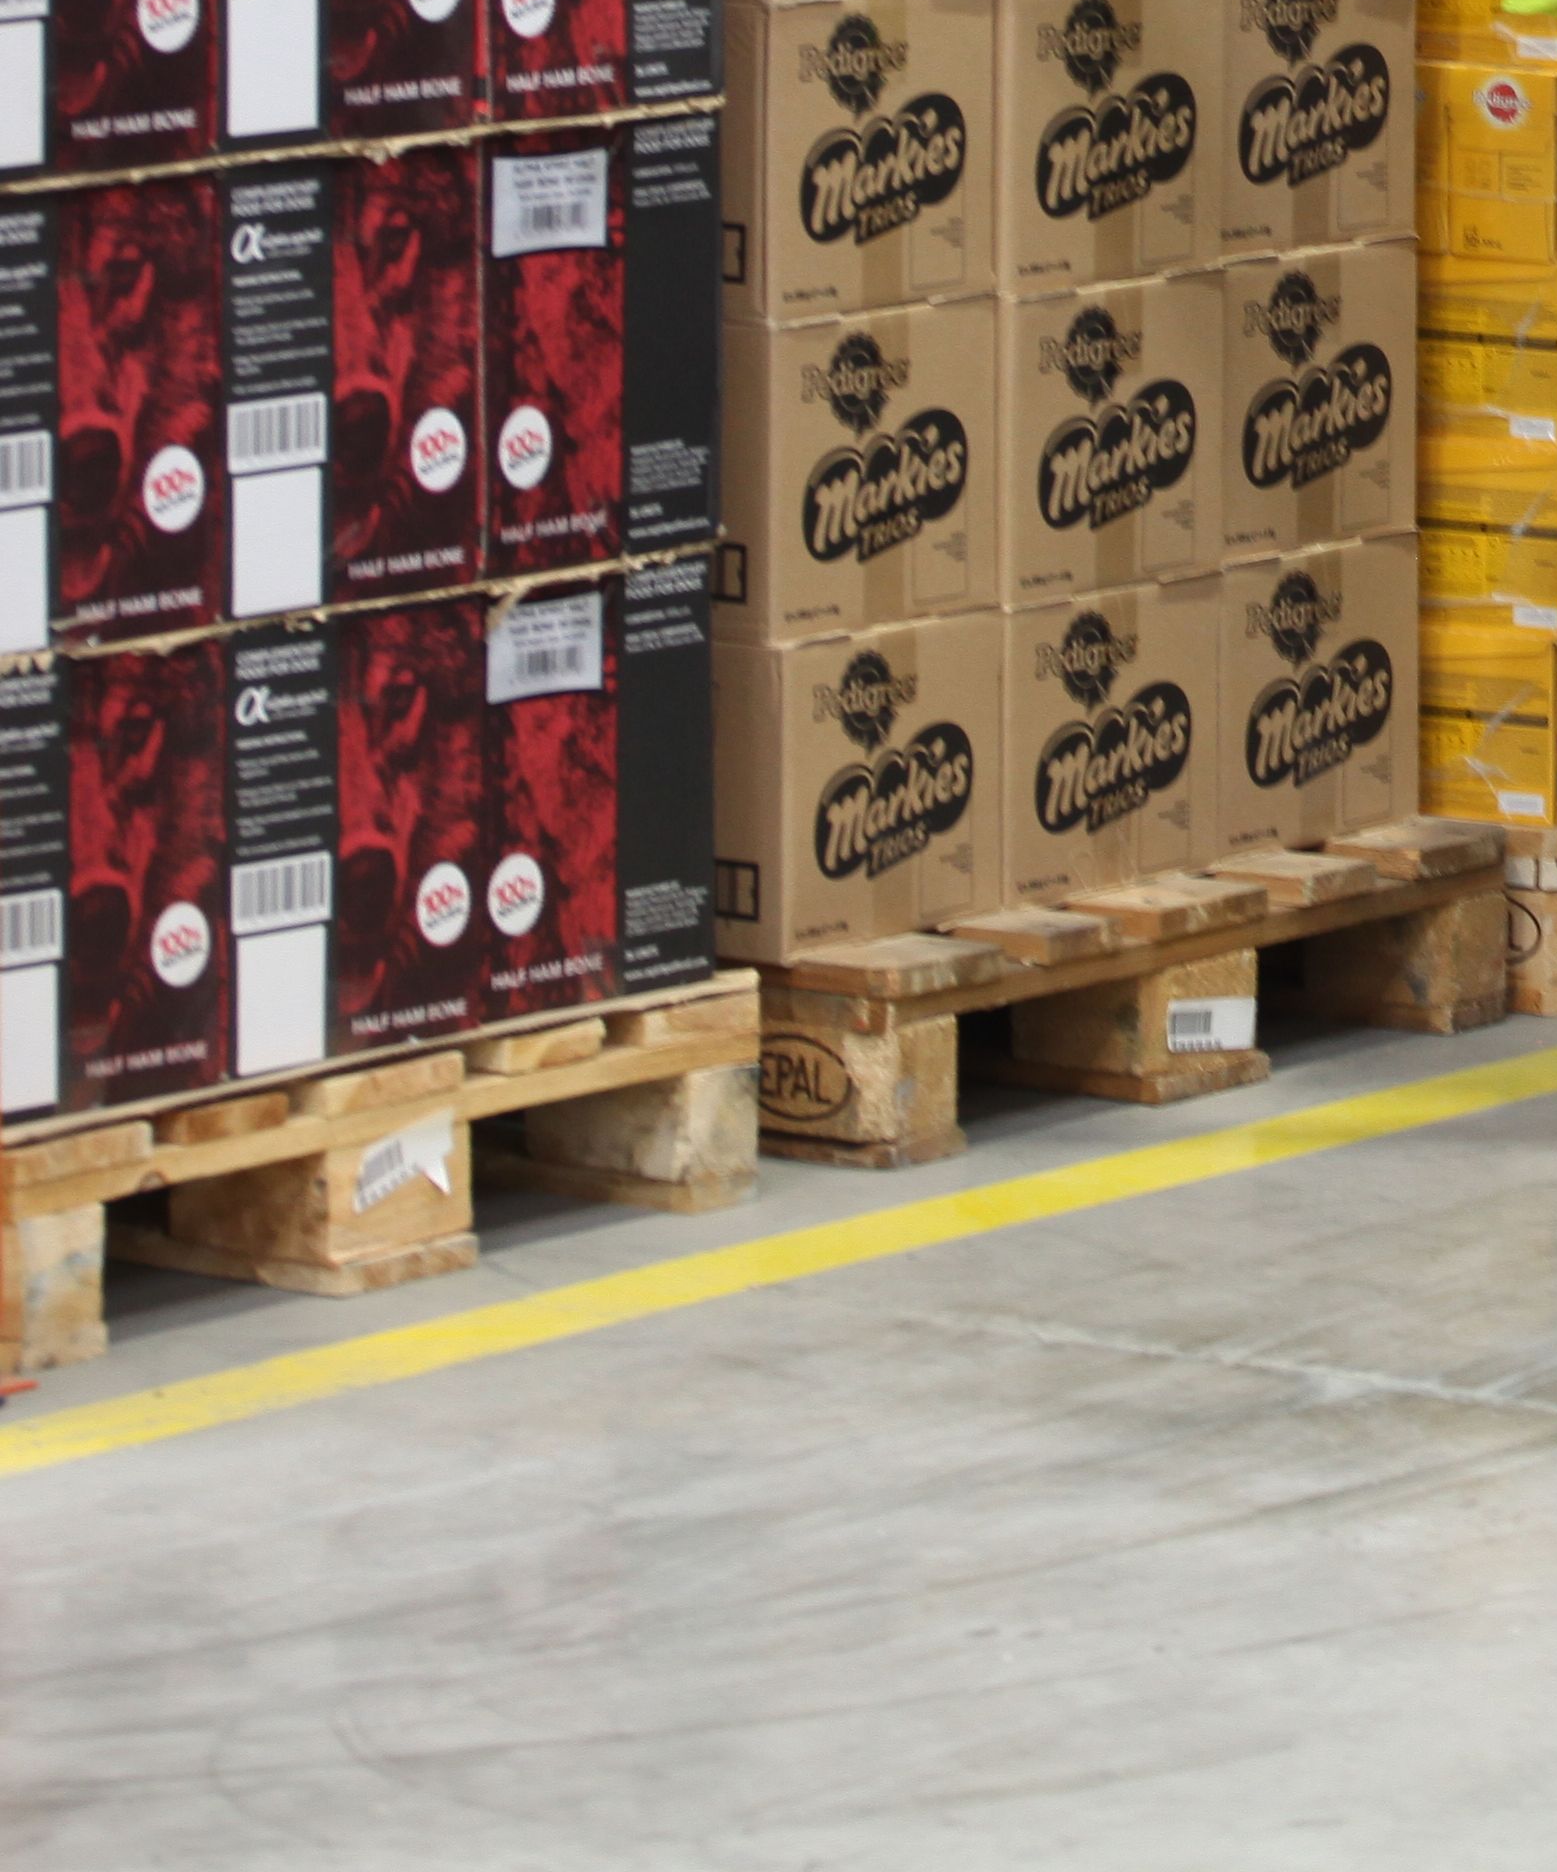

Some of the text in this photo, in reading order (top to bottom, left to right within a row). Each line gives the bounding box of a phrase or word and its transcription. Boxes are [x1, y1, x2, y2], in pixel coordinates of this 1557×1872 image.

[799, 41, 907, 81] Pedigree
[1036, 20, 1141, 61] Pedigree
[1250, 60, 1385, 175] Markies
[811, 111, 962, 234] Markies
[1045, 89, 1191, 209] Markies
[1288, 137, 1347, 186] TRIOS
[856, 192, 920, 244] TRIOS
[1088, 169, 1150, 220] TRIOS
[1243, 289, 1342, 338] Pedigree
[1040, 331, 1142, 373] Pedigree
[800, 358, 910, 402] Pedigree
[1254, 359, 1387, 478] Markies
[1049, 395, 1190, 522] Markies
[1293, 435, 1351, 489] TRIOS
[813, 426, 964, 551] Markies
[1090, 477, 1150, 528] TRIOS
[857, 507, 921, 564] TRIOS
[1246, 589, 1342, 641] Pedigree
[1035, 633, 1138, 680] Pedigree
[813, 671, 917, 722] Pedigree
[1255, 656, 1388, 778] Markies
[1045, 698, 1188, 824] Markies
[1293, 733, 1351, 788] TRIOS
[824, 739, 969, 870] Markies
[1087, 777, 1148, 833] TRIOS
[867, 820, 929, 878] TRIOS
[759, 1052, 832, 1104] EPAL
